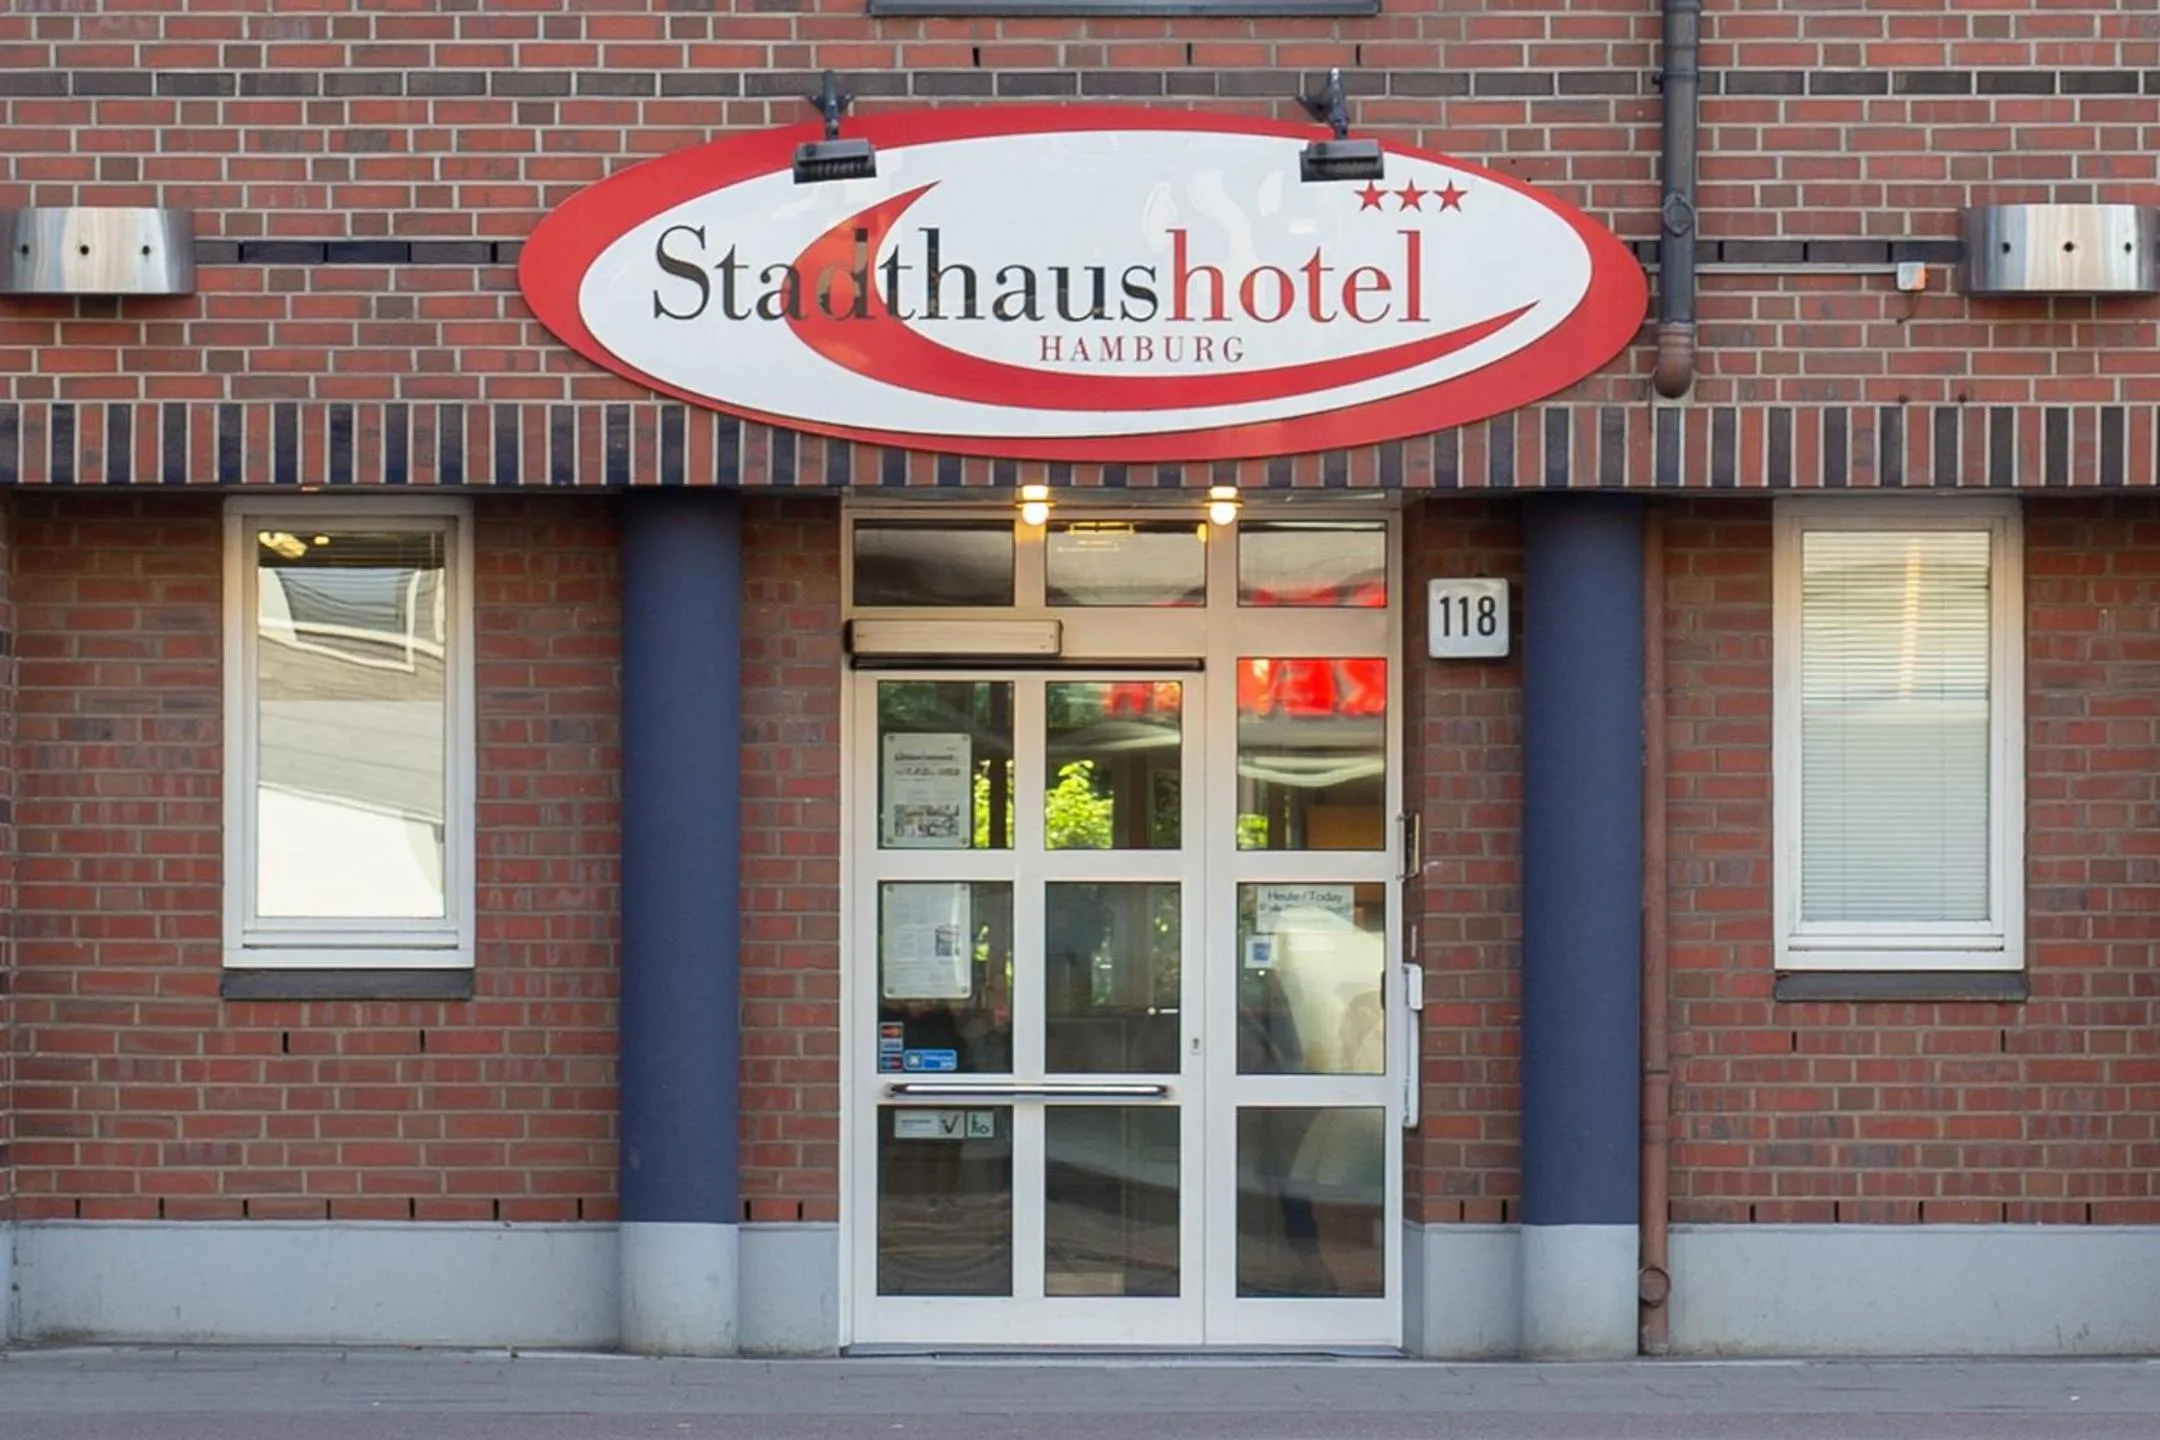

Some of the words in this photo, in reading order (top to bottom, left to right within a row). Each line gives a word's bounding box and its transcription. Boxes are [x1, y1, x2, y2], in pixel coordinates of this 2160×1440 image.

[653, 224, 1432, 322] Stadthaushotel
[1040, 335, 1245, 363] HAMBURG
[1439, 595, 1497, 637] 118
